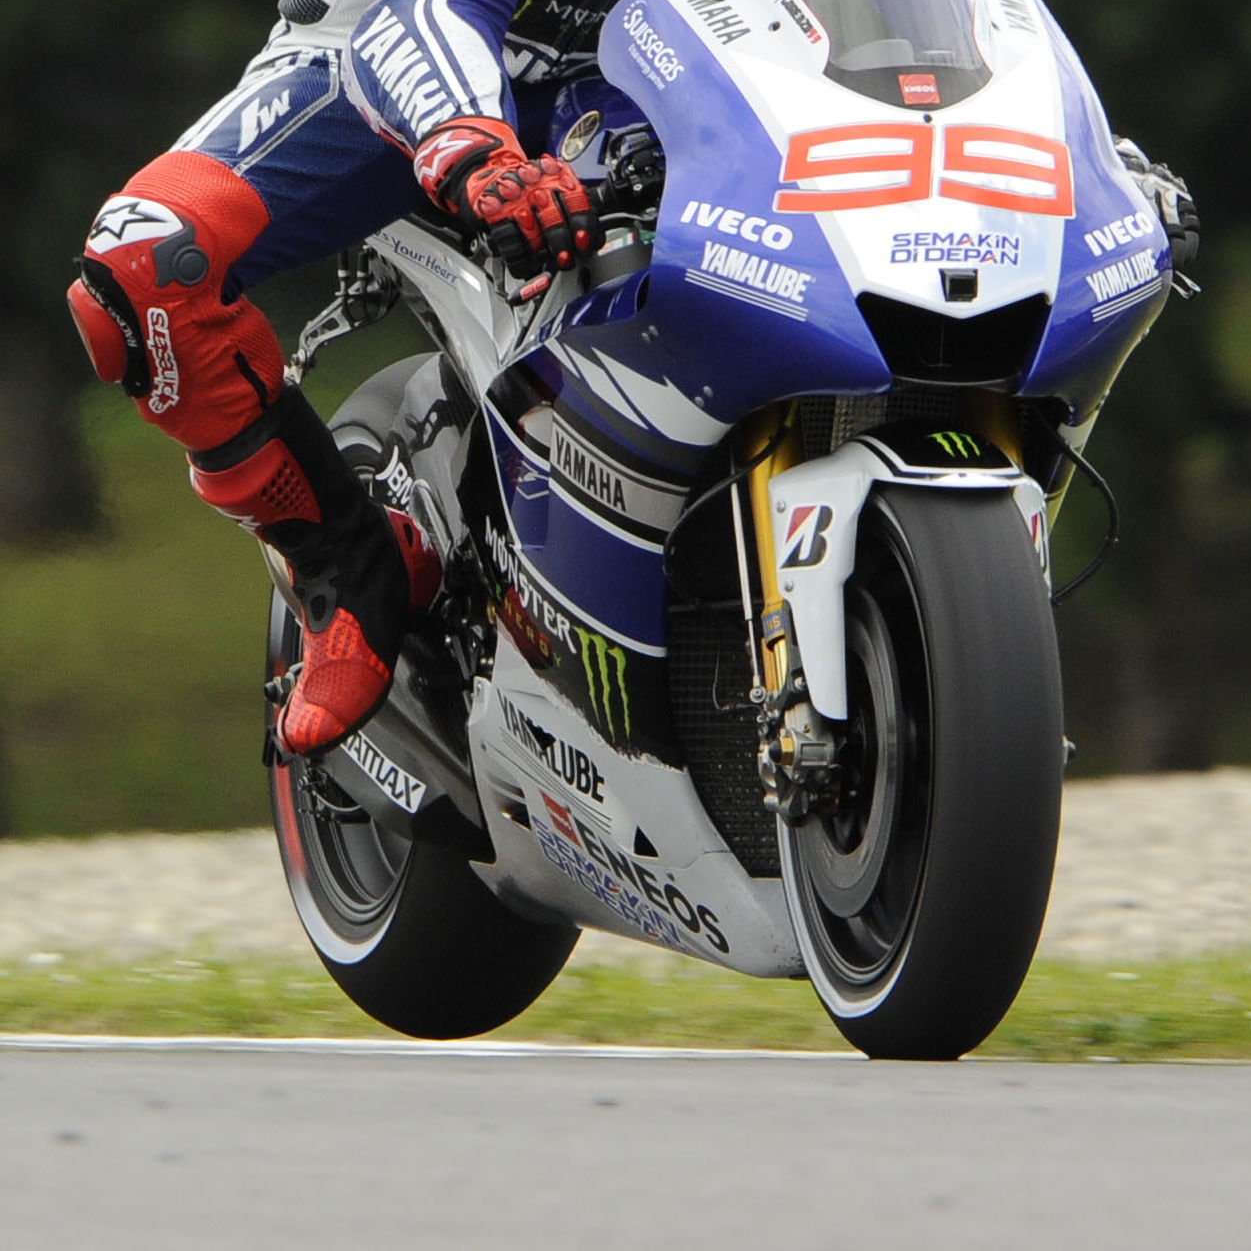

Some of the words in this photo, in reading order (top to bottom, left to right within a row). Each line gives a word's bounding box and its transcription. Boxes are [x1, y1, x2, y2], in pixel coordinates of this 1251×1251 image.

[352, 5, 457, 140] YAMAHA
[773, 121, 1076, 218] 99
[680, 200, 793, 251] IVECO
[924, 248, 1019, 266] DEPAN
[1083, 211, 1154, 257] IVECO
[700, 239, 812, 303] YAMALUBE
[1085, 248, 1160, 303] YAMALUBE
[556, 429, 627, 513] YAMAHA
[485, 515, 578, 655] MONSTER
[344, 732, 422, 810] ATTLAX
[573, 816, 730, 955] ENEOS
